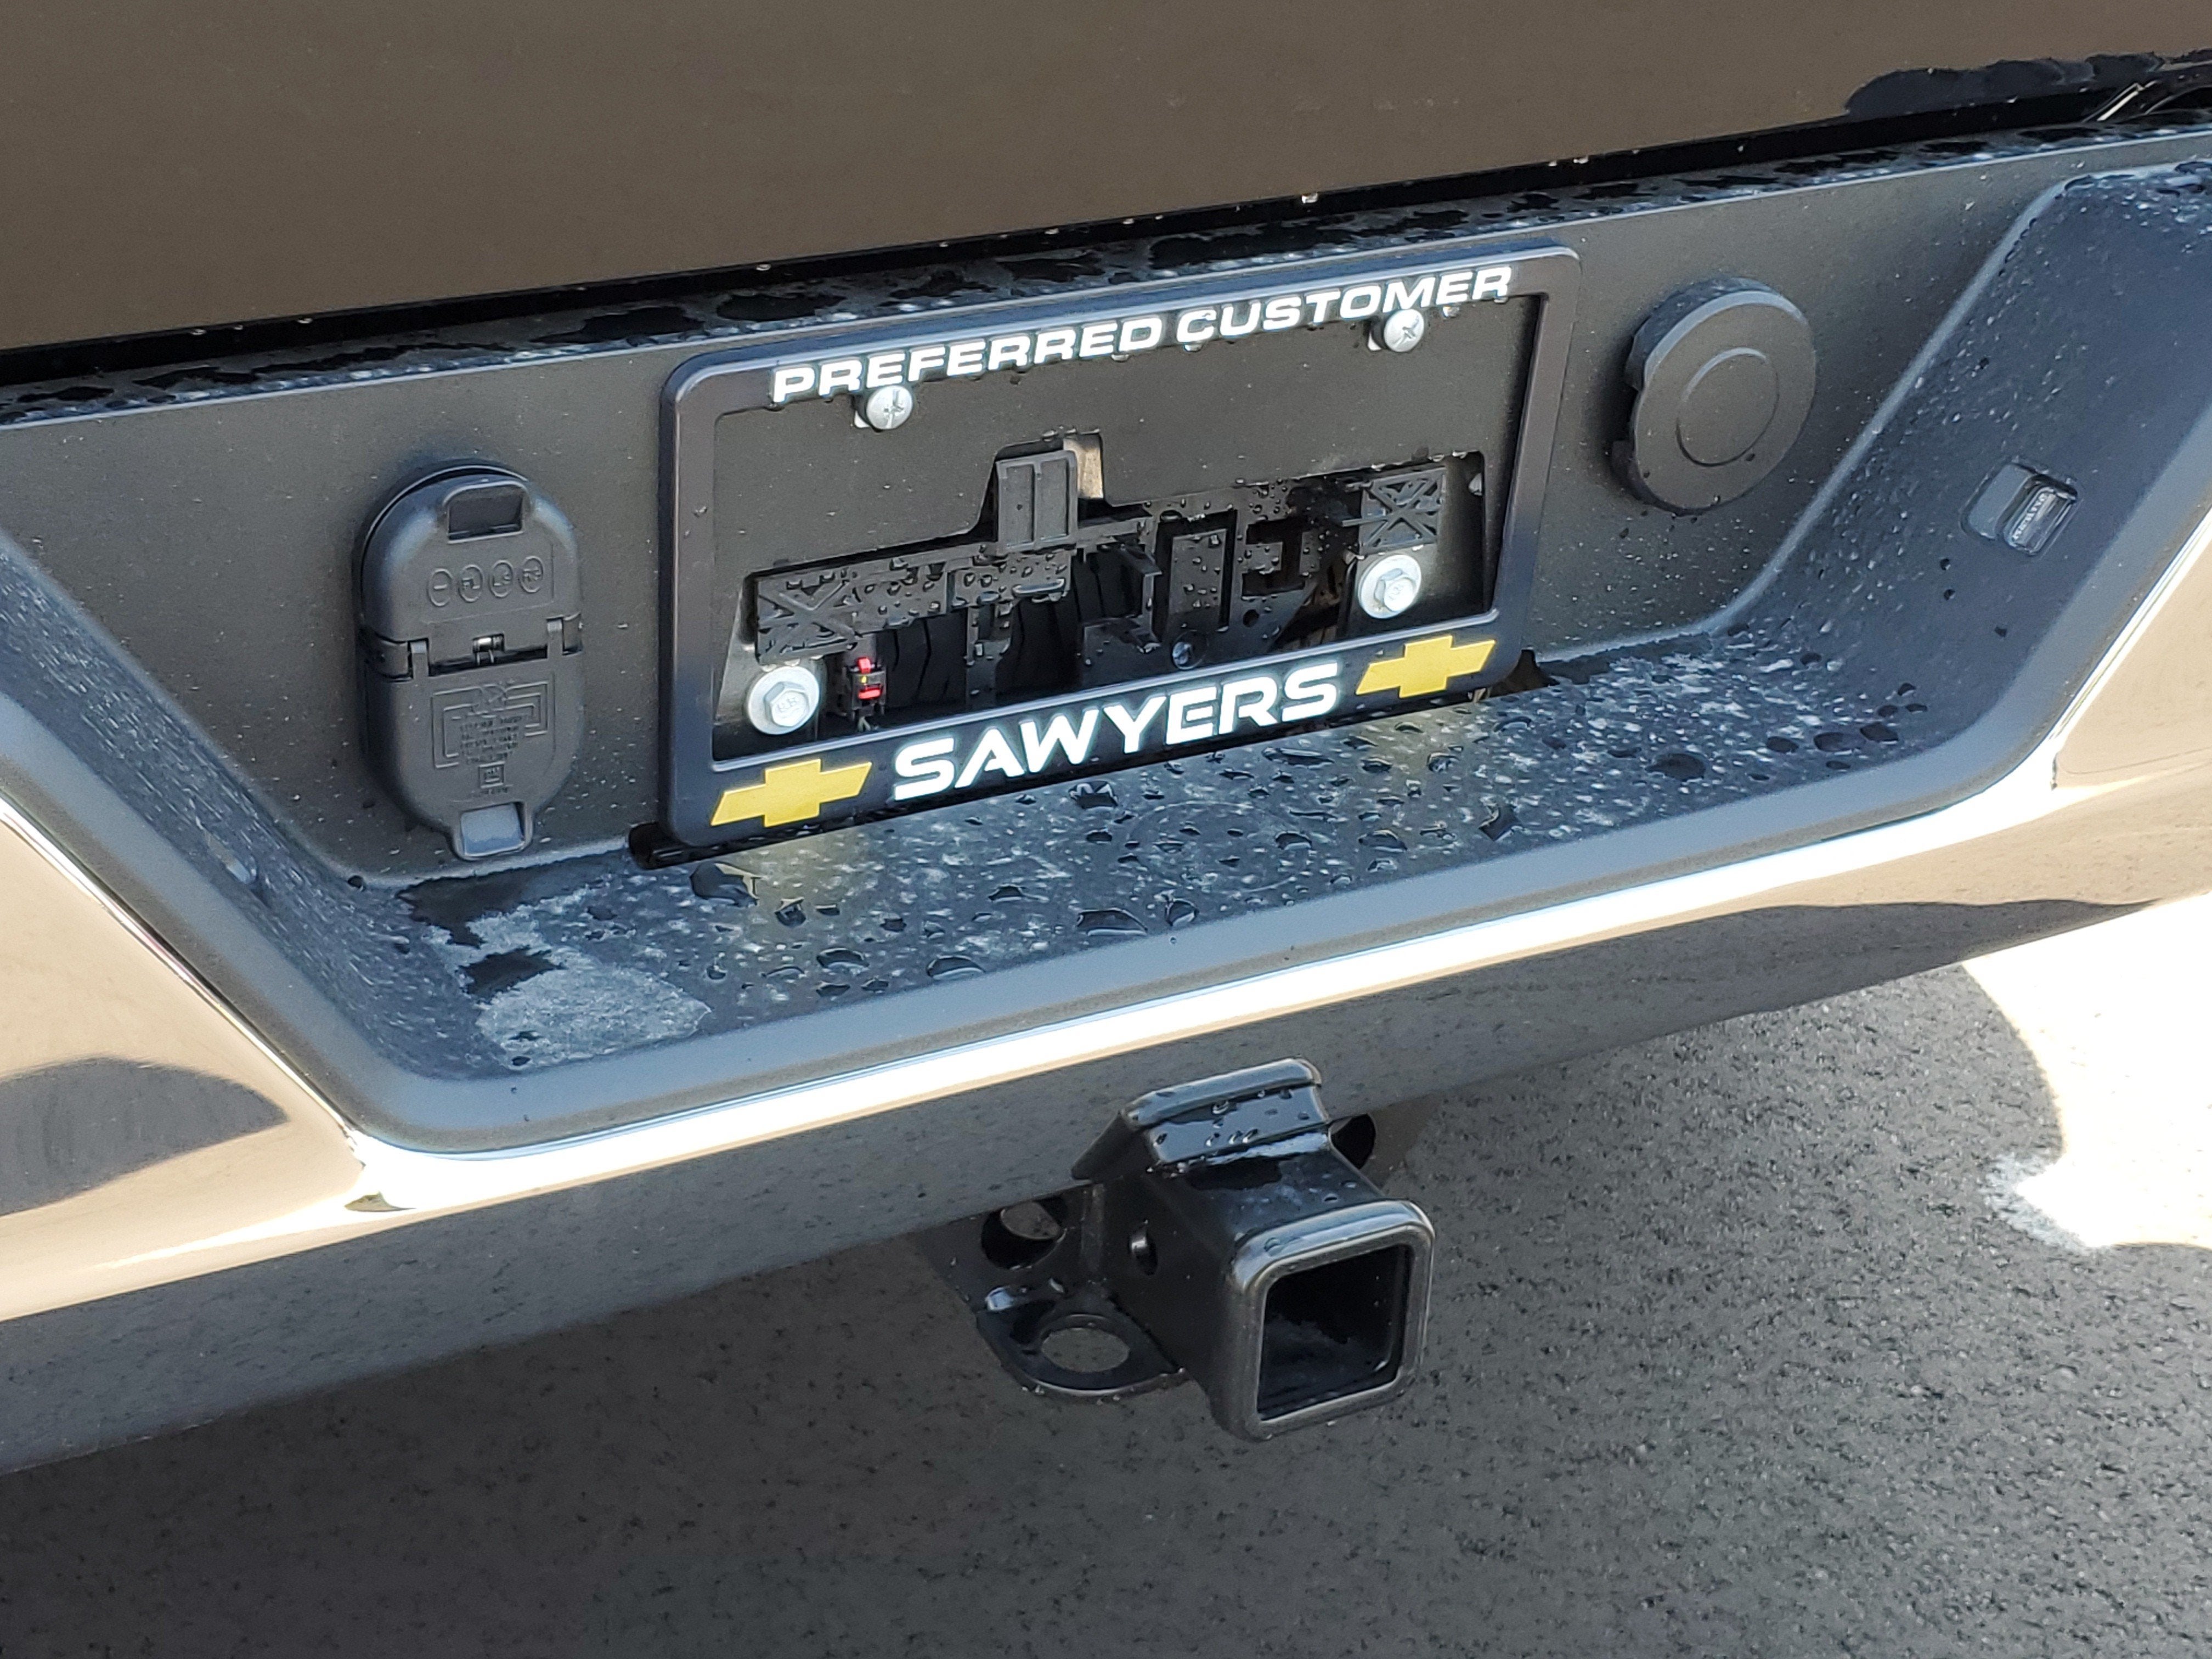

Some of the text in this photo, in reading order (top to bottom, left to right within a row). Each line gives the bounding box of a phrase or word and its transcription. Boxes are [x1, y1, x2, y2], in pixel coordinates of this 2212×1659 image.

[772, 264, 1513, 404] PREFERRED CUSTOMER
[893, 661, 1339, 802] SAWYERS
